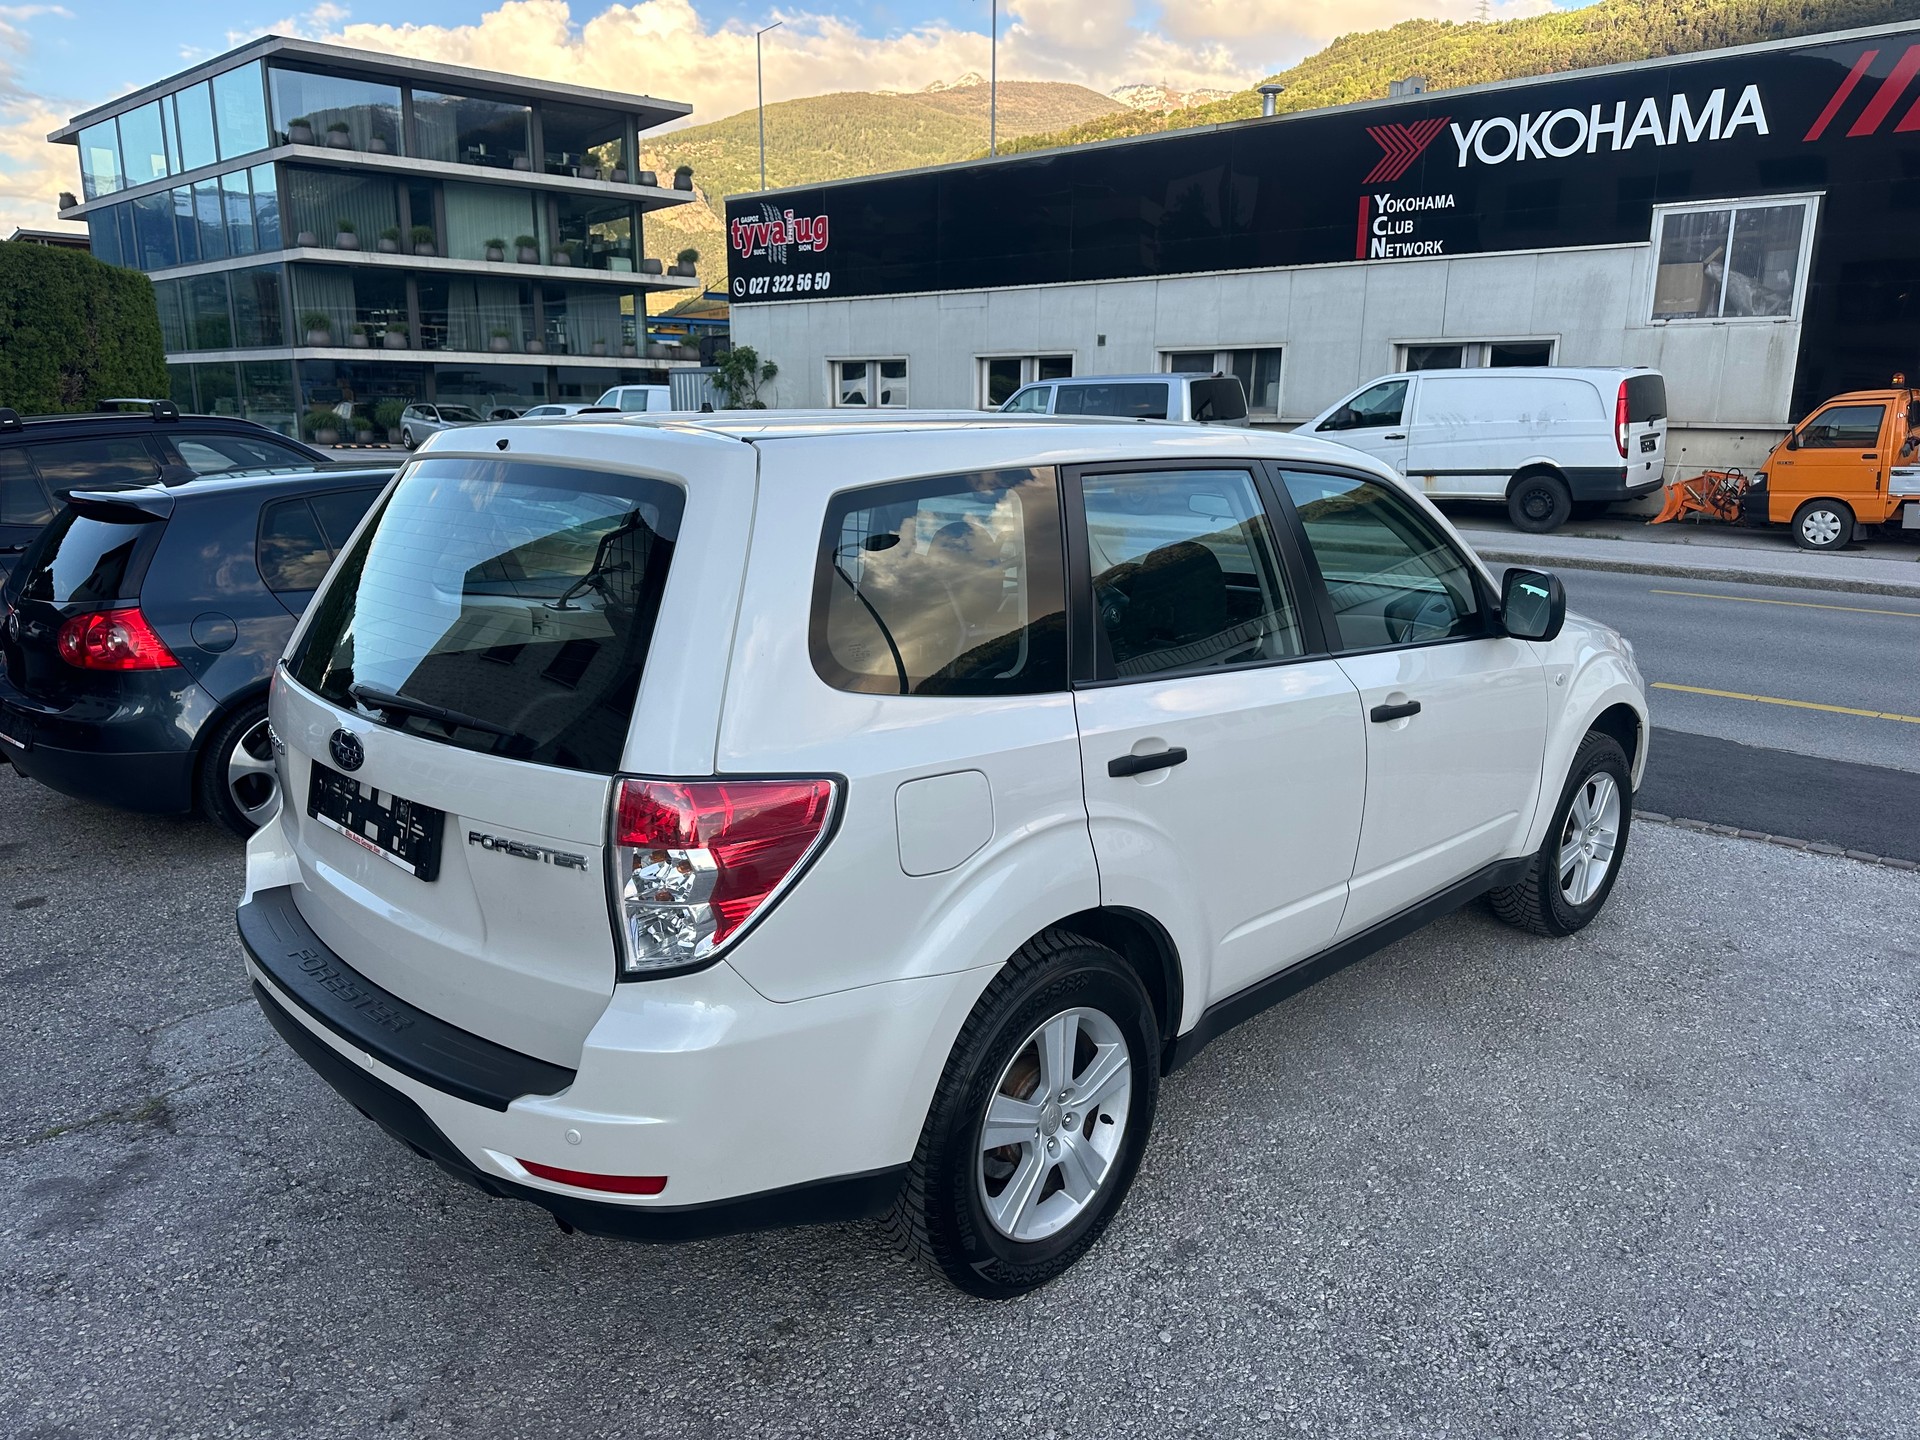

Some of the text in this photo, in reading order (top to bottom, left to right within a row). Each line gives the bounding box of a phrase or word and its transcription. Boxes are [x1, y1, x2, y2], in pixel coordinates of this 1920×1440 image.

[1450, 84, 1769, 167] YOKOHAMA
[1373, 193, 1455, 213] YOKOHAMA
[740, 215, 759, 223] GASPOZ
[1372, 216, 1414, 235] CLUB
[732, 209, 829, 258] tyvalug
[798, 244, 812, 252] SION
[1370, 237, 1444, 258] NETWORK
[749, 272, 831, 294] 027 322 56 50
[468, 830, 589, 872] FORESTER
[287, 948, 415, 1033] FORESTER
